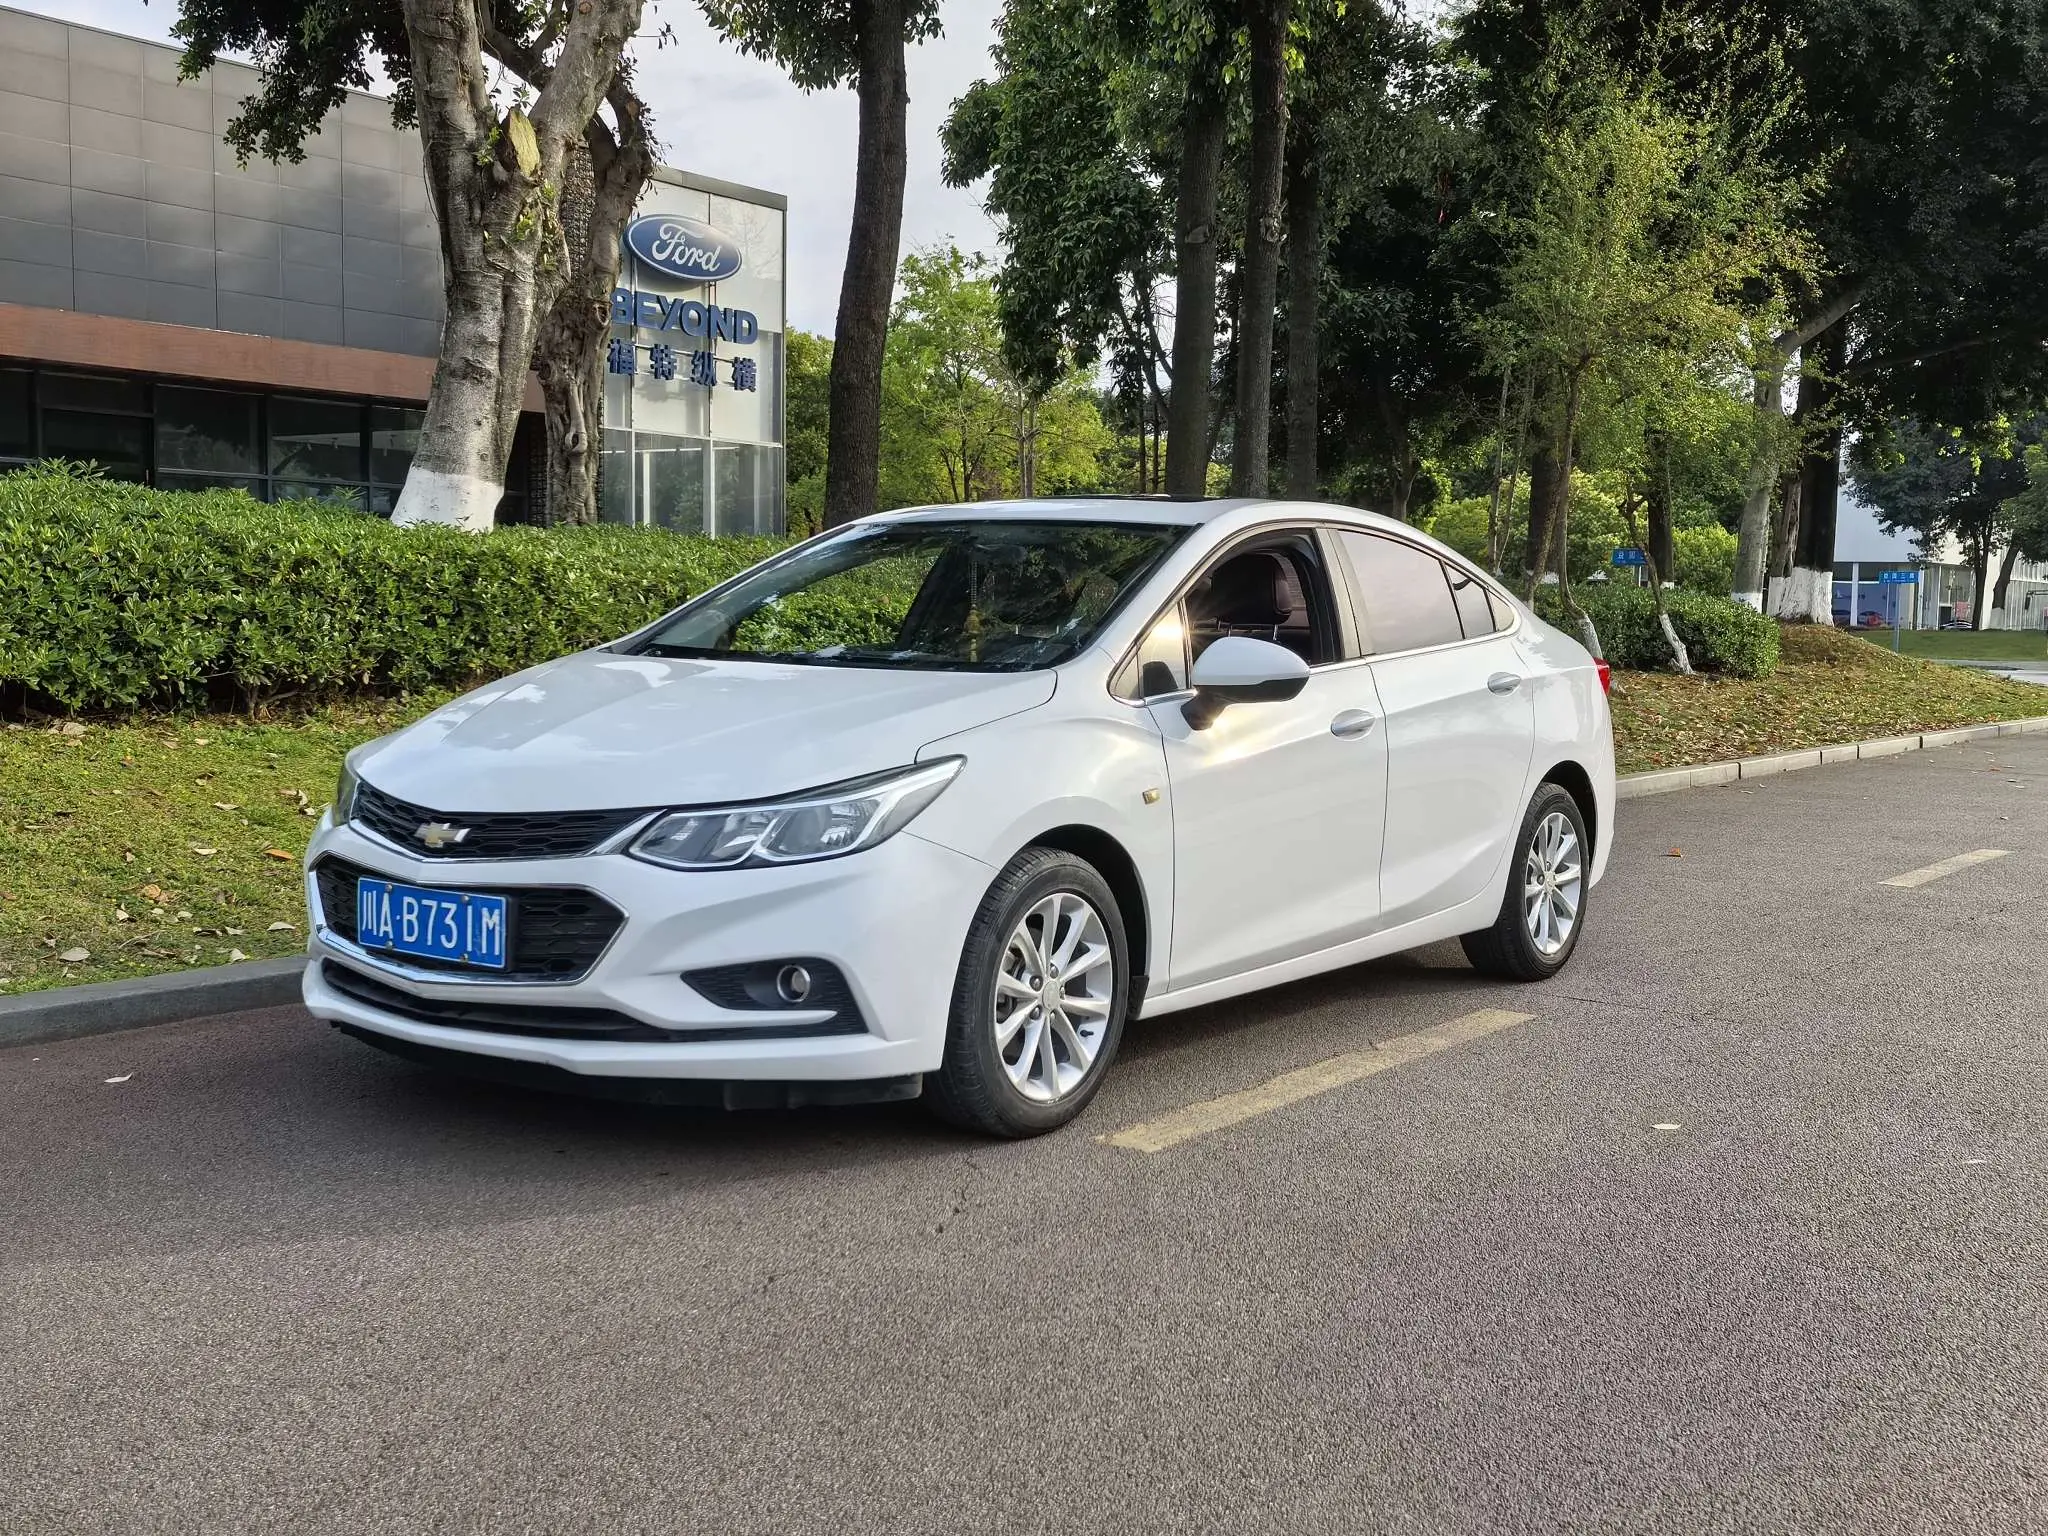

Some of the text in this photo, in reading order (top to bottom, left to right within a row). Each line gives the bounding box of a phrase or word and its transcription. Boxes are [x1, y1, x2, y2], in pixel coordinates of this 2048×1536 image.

[651, 223, 721, 271] Ford
[612, 288, 758, 344] BEYOND
[608, 339, 757, 392] 福特纵横
